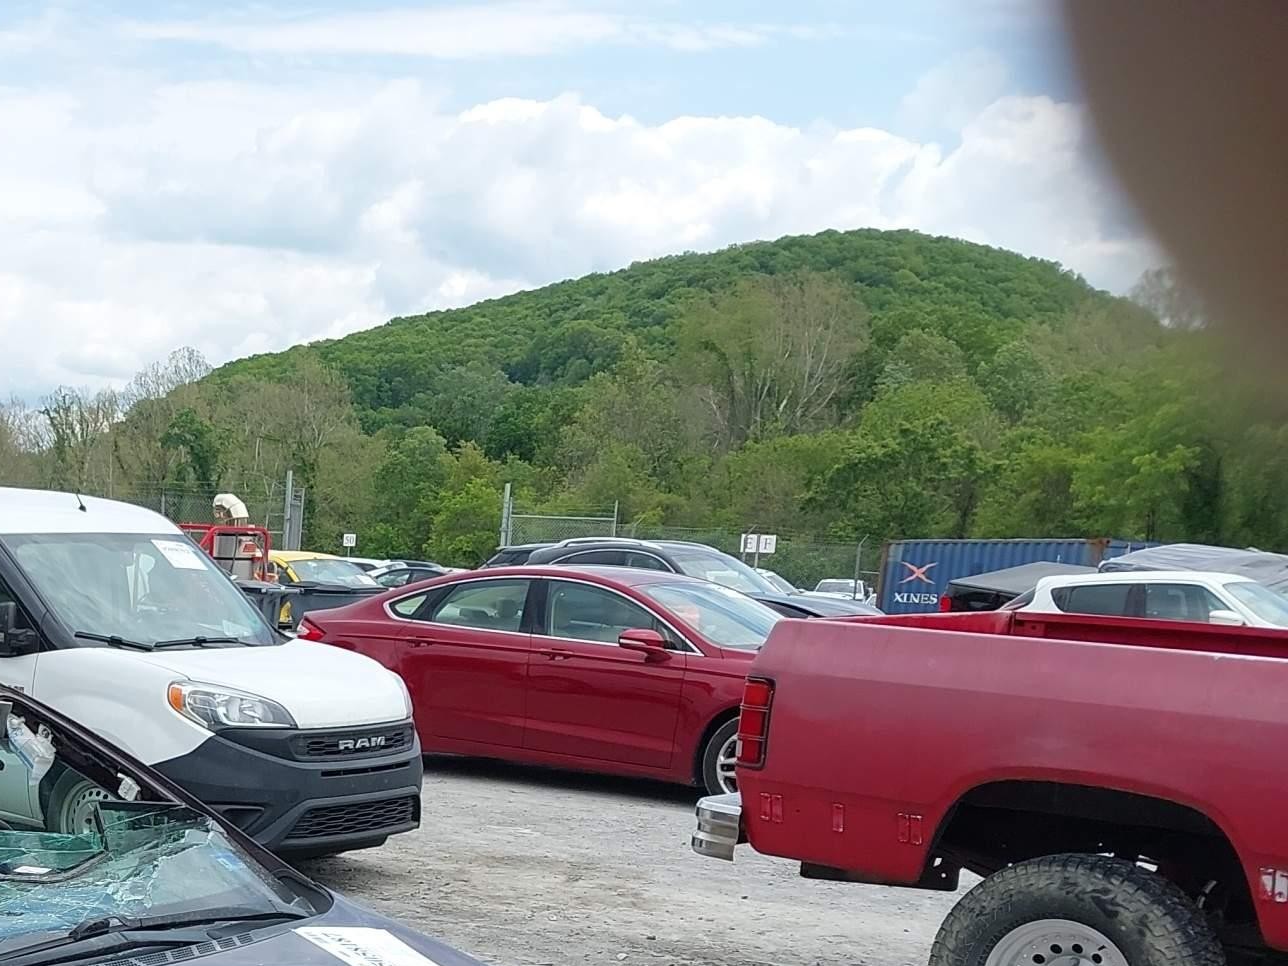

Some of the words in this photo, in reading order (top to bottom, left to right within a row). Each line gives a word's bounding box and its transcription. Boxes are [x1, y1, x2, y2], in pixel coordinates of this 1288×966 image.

[763, 537, 772, 550] F
[893, 592, 938, 605] XINES
[338, 736, 386, 750] RAM
